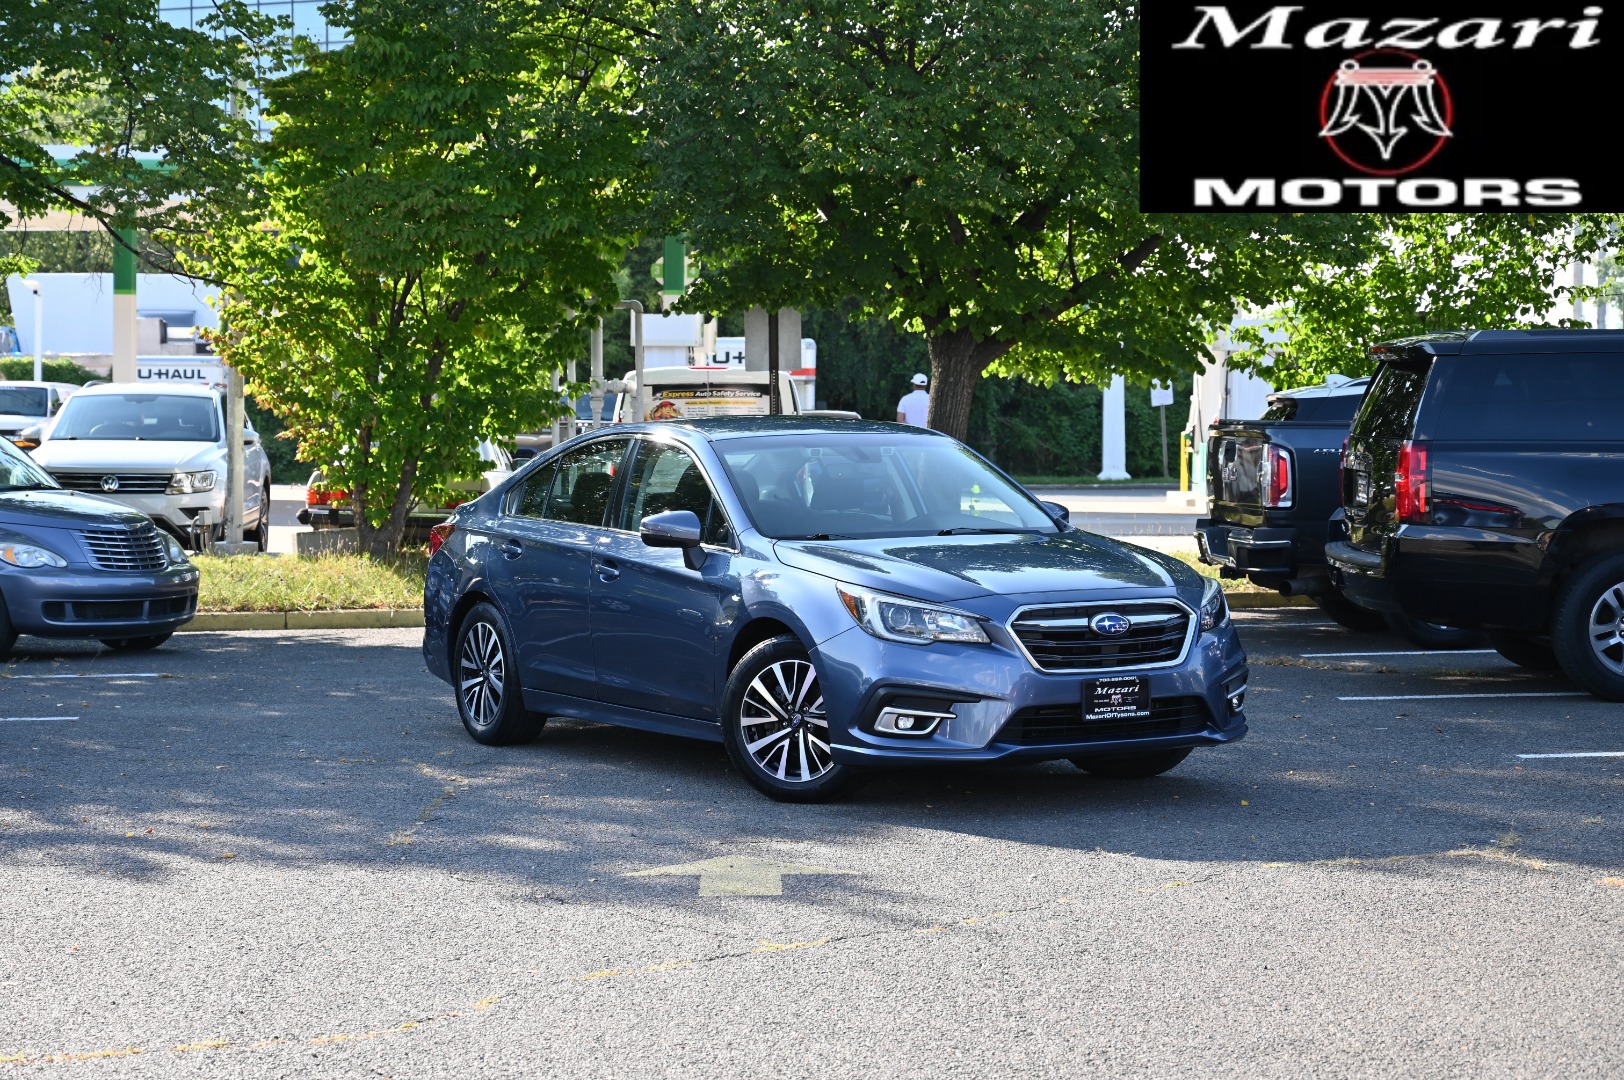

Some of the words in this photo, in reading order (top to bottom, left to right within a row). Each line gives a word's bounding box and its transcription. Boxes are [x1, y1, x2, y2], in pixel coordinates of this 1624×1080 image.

[137, 368, 207, 380] U-HAUL
[712, 390, 735, 398] Safety
[1094, 684, 1140, 695] Mazari
[1094, 705, 1137, 713] MOTORS
